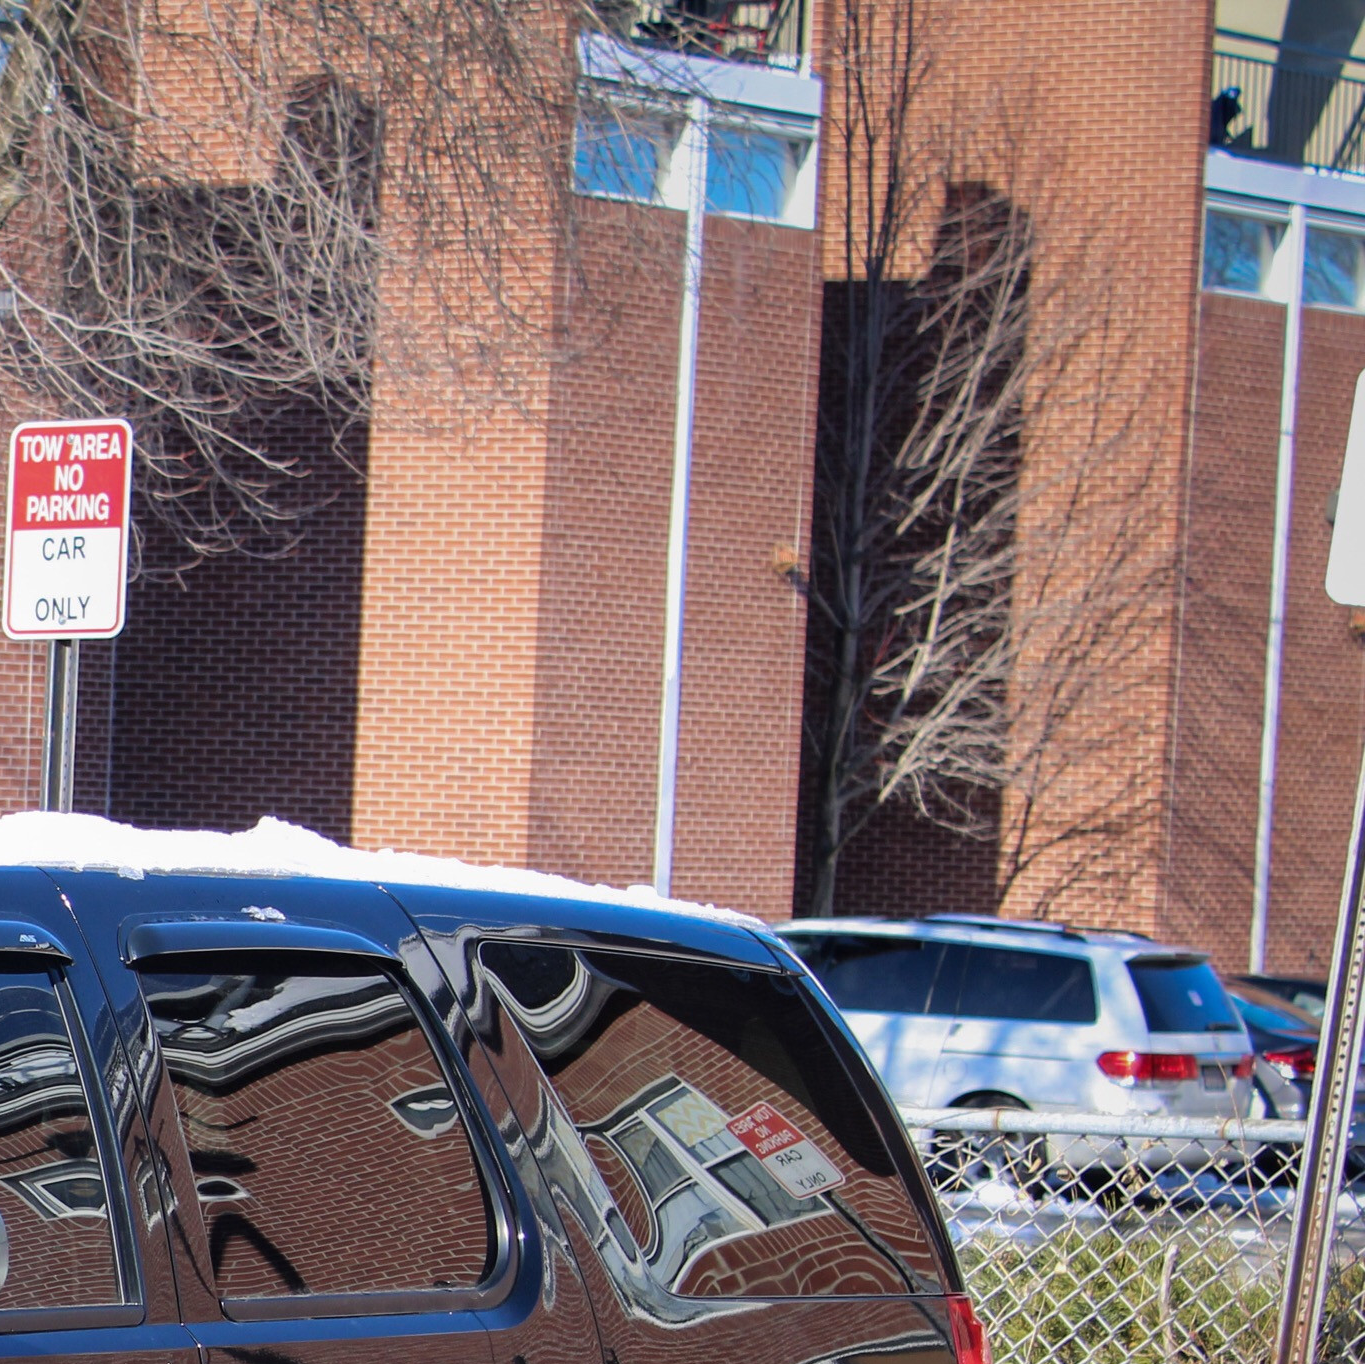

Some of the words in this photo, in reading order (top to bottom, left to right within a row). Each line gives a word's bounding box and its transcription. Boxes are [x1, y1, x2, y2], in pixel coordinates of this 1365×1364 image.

[20, 435, 64, 463] TOW
[69, 433, 122, 461] AREA
[54, 463, 84, 491] NO
[26, 493, 109, 522] PARKING
[42, 536, 86, 561] CAR
[35, 596, 90, 621] ONLY
